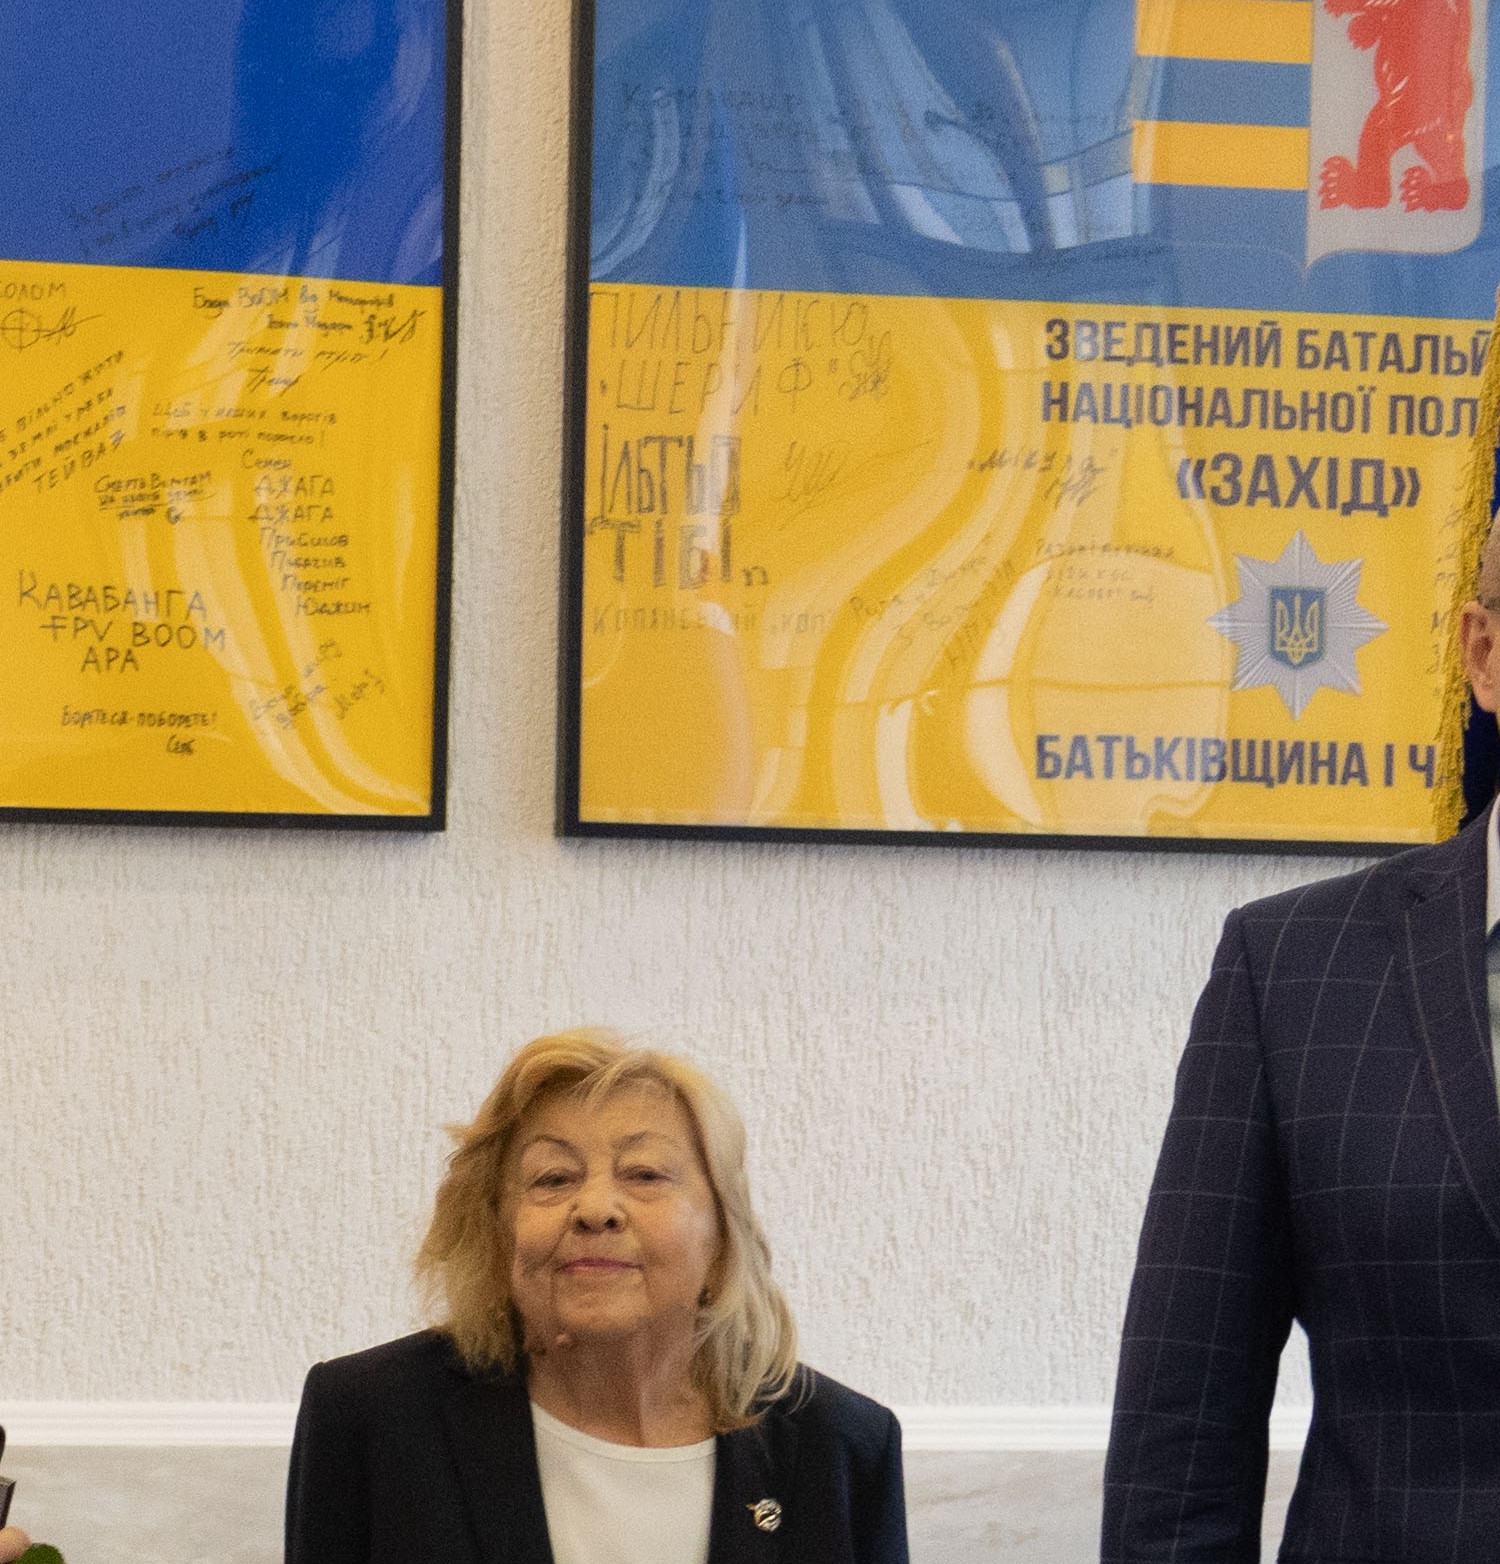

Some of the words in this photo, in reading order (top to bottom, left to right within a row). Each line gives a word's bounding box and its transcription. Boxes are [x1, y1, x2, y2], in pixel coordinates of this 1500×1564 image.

[1044, 318, 1283, 370] ЗВЕДЕНИЙ
[1040, 379, 1374, 438] НАЦІОНАЛЬНОЇ
[1388, 394, 1481, 438] ПОЛ
[1175, 452, 1422, 519] «ЗАХІД»
[18, 568, 208, 622] КАВАБАНГА
[39, 614, 114, 642] FPV
[132, 620, 226, 652] BOOM
[1034, 733, 1370, 789] БАТЬКІВЩИНА
[1384, 743, 1394, 787] І
[1408, 744, 1436, 790] Ч
